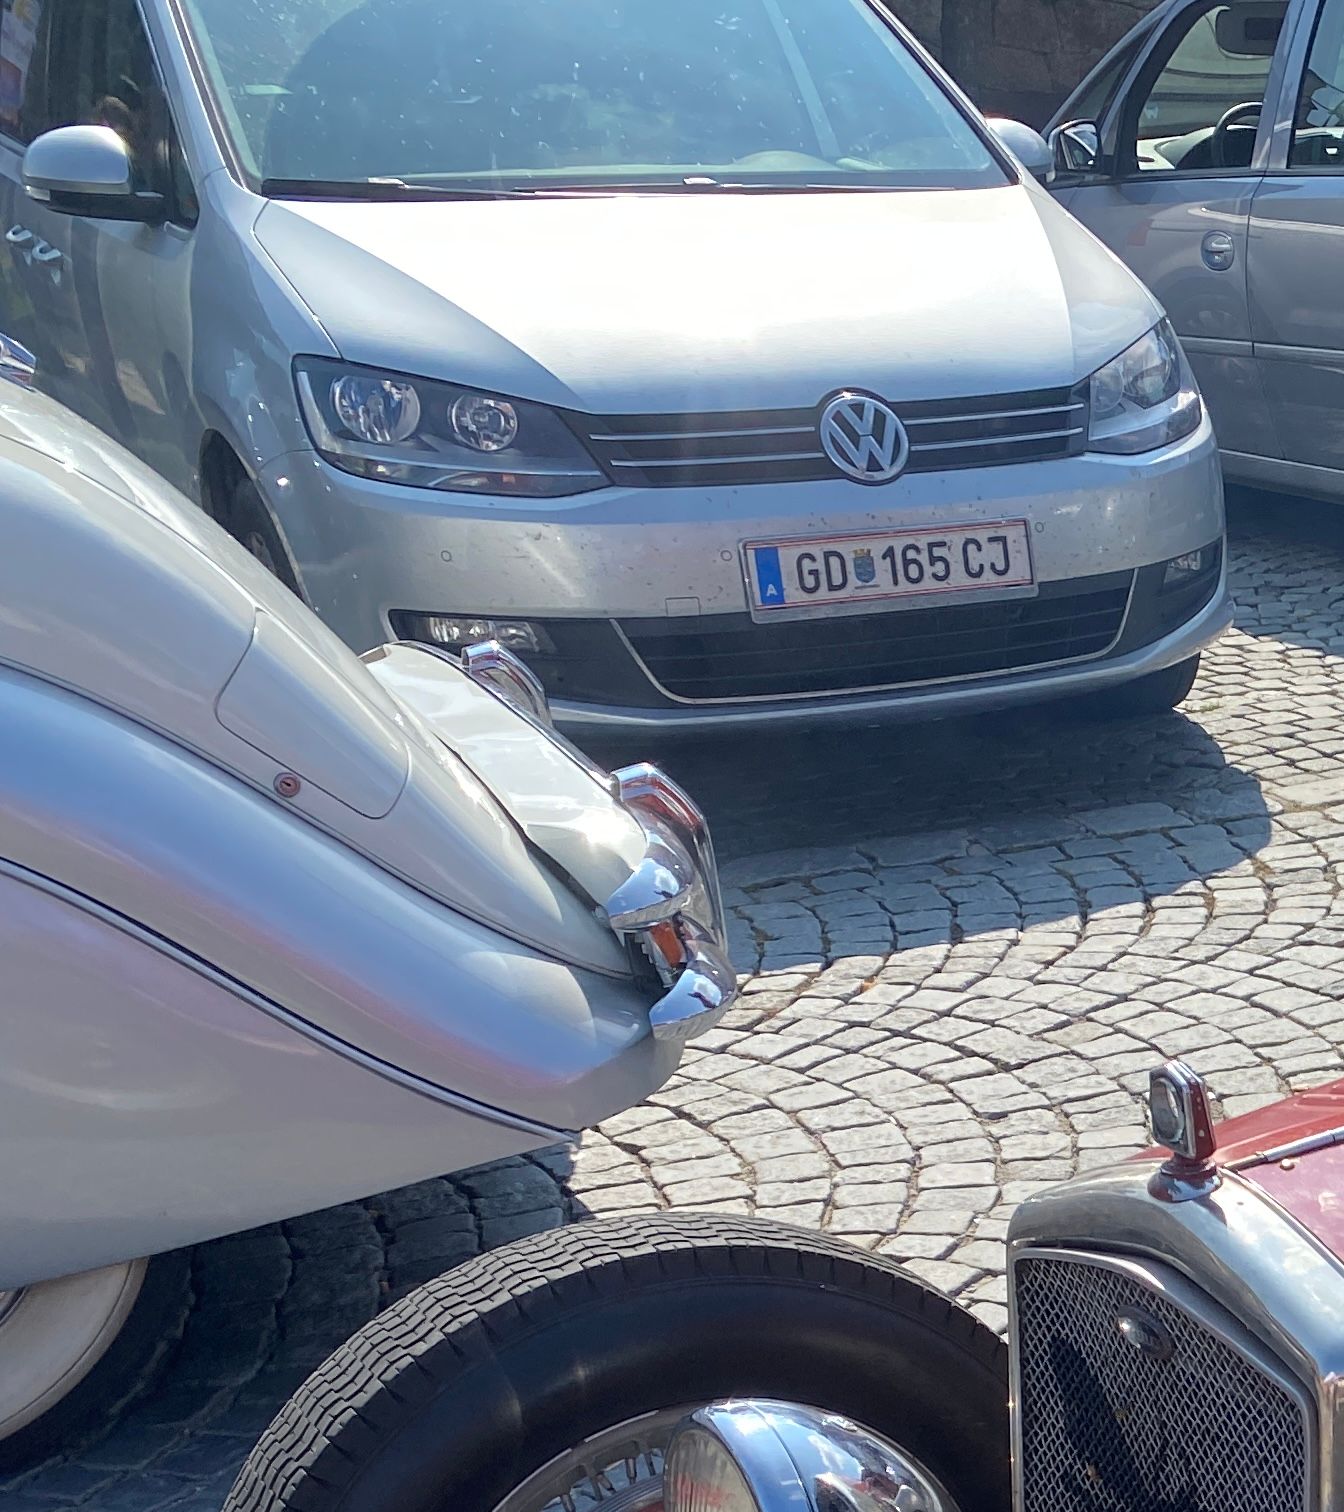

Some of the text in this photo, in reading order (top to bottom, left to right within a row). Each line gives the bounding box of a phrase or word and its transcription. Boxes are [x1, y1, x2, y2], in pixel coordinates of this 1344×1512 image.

[796, 536, 1010, 593] GD 165 CJ
[767, 584, 777, 596] A
